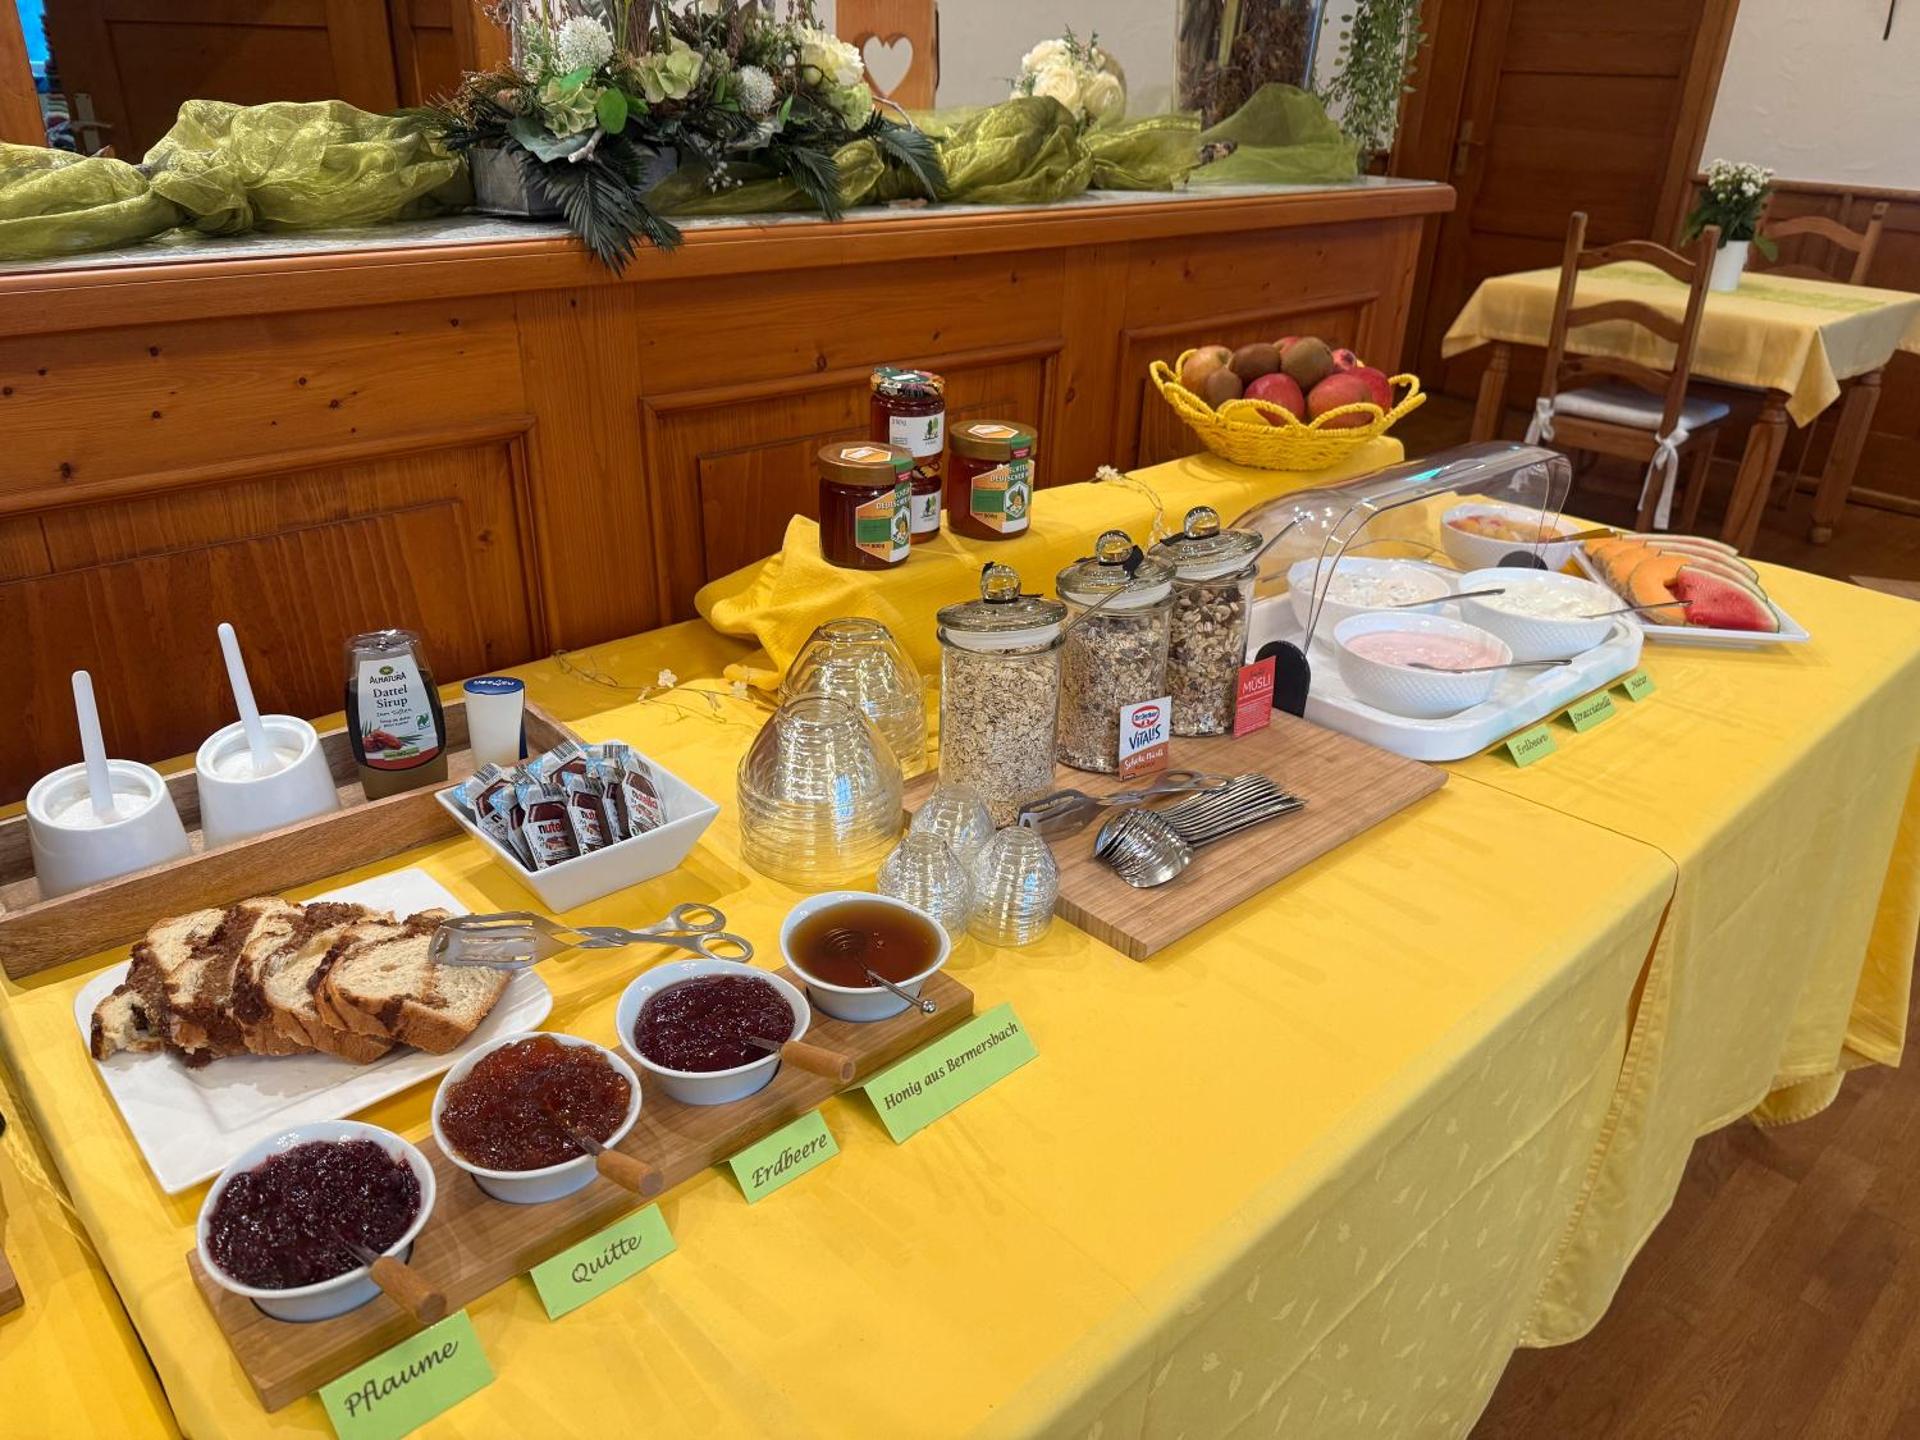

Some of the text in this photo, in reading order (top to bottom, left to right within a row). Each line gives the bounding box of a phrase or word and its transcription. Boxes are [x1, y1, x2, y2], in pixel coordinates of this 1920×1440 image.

[369, 671, 407, 685] ALNATURA
[373, 684, 408, 699] Dattel
[1243, 674, 1271, 695] MÜSLI
[376, 697, 408, 709] Sirup
[1574, 696, 1612, 724] Stracciatella
[883, 1022, 1019, 1111] Honig aus Bermersbach
[751, 1133, 828, 1189] Erdbeere
[571, 1234, 642, 1284] Quitte
[344, 1341, 459, 1418] Pflaume
